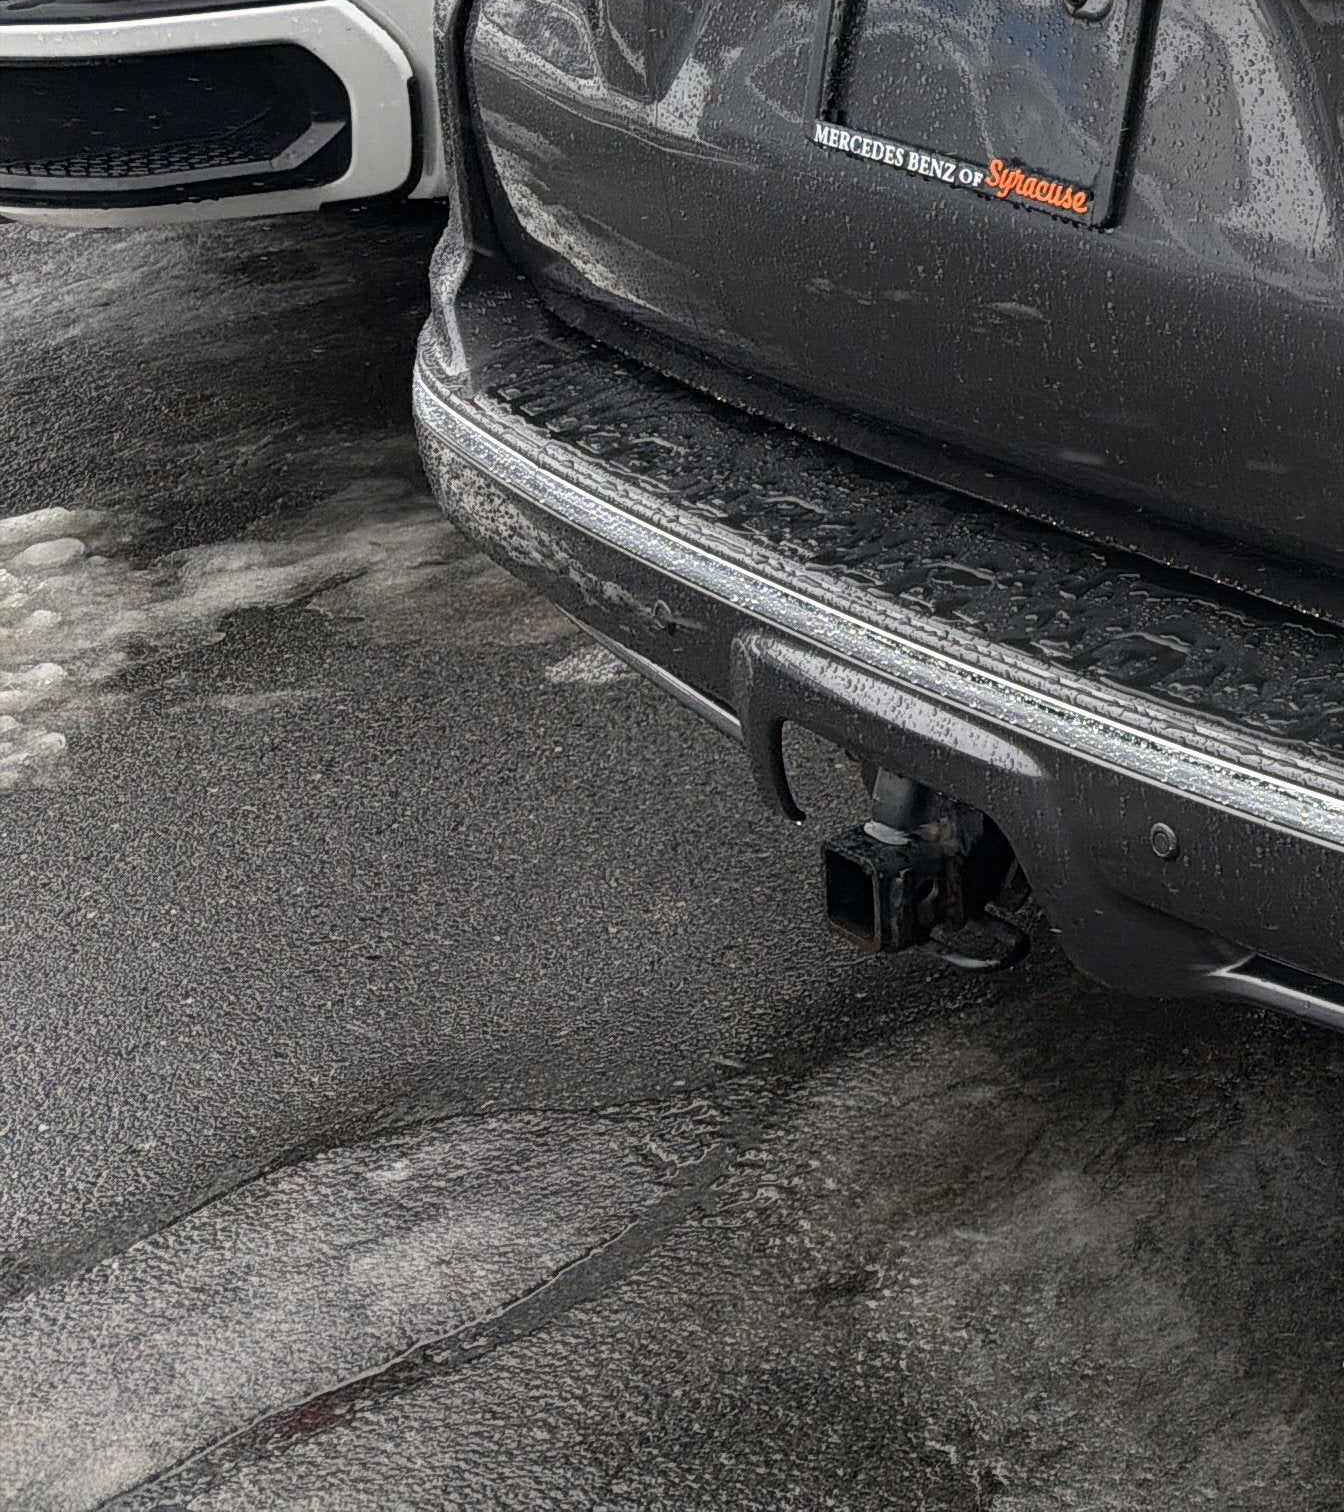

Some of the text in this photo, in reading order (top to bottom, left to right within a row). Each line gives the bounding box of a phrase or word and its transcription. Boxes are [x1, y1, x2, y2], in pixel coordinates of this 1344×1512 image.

[814, 123, 1089, 214] MERCEDES BENZ OF Syracuse
